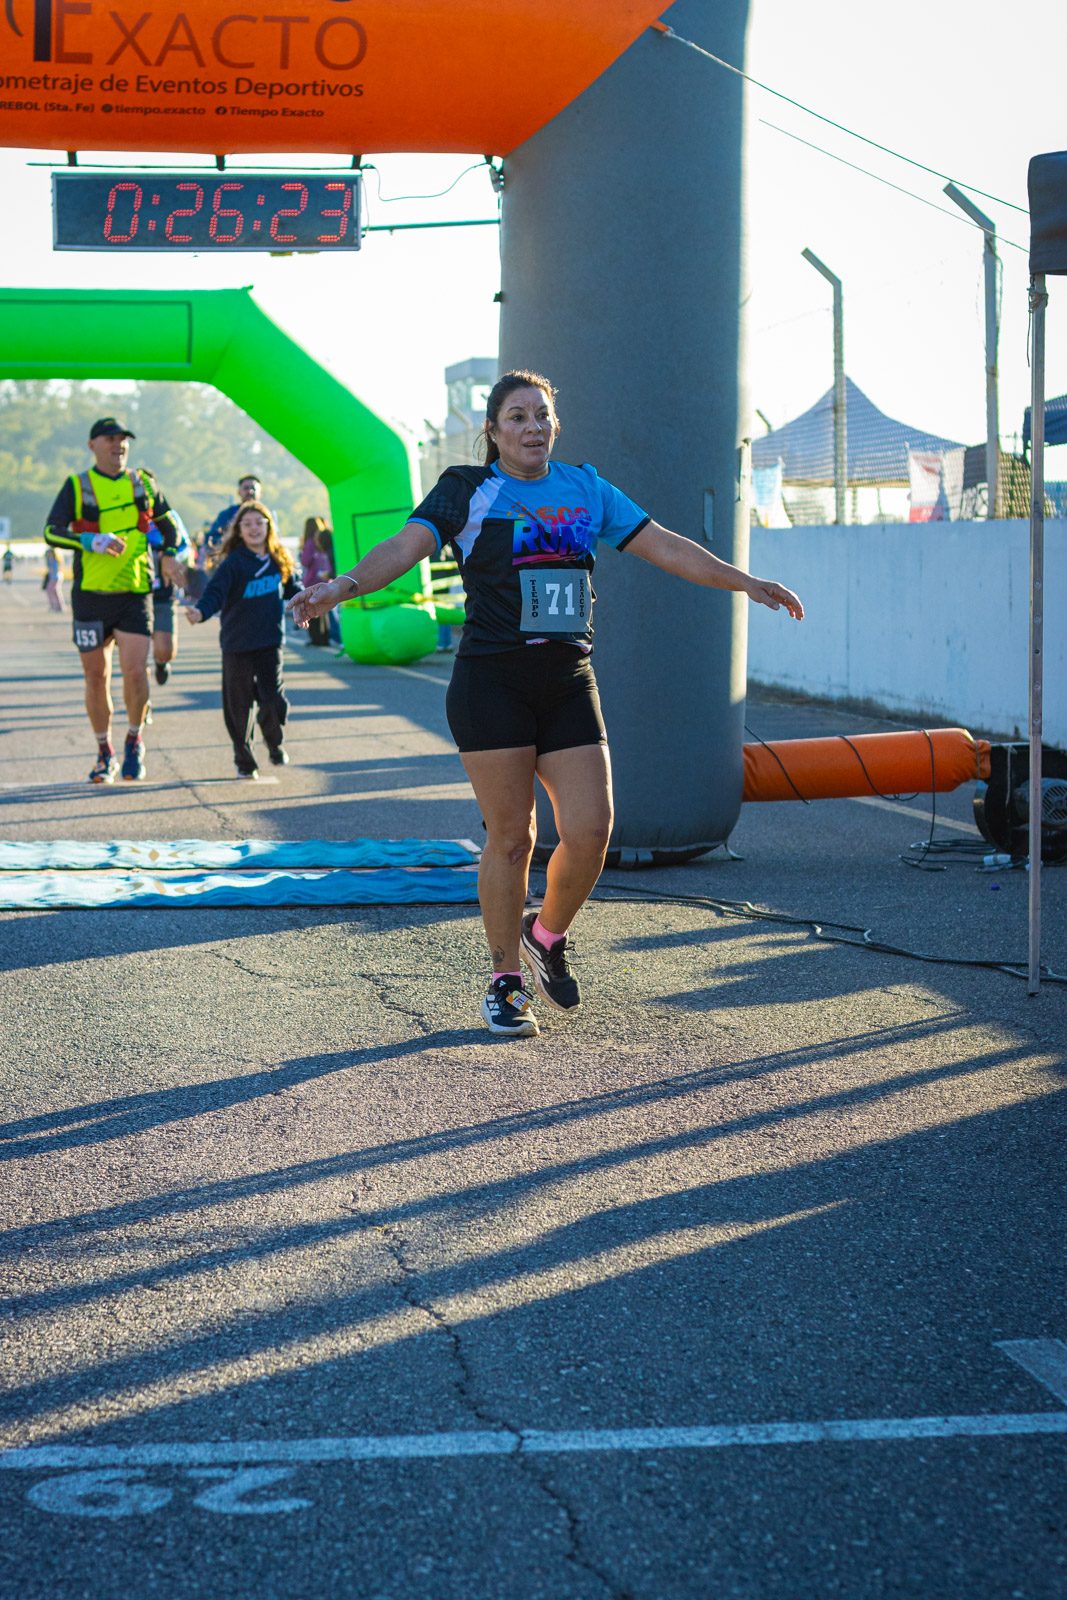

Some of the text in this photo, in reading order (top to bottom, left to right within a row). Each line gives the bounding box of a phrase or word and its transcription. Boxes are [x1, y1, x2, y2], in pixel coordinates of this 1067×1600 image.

[99, 74, 129, 93] de
[136, 75, 228, 95] Eventos
[235, 77, 364, 99] Deportivos
[76, 102, 95, 113] Fe)
[230, 106, 278, 118] Tiempo
[281, 107, 325, 118] Exacto
[103, 182, 352, 243] 0:26:23
[512, 520, 590, 556] RUN
[529, 579, 539, 618] TIEMPO
[545, 583, 575, 615] 71
[75, 629, 98, 647] 153
